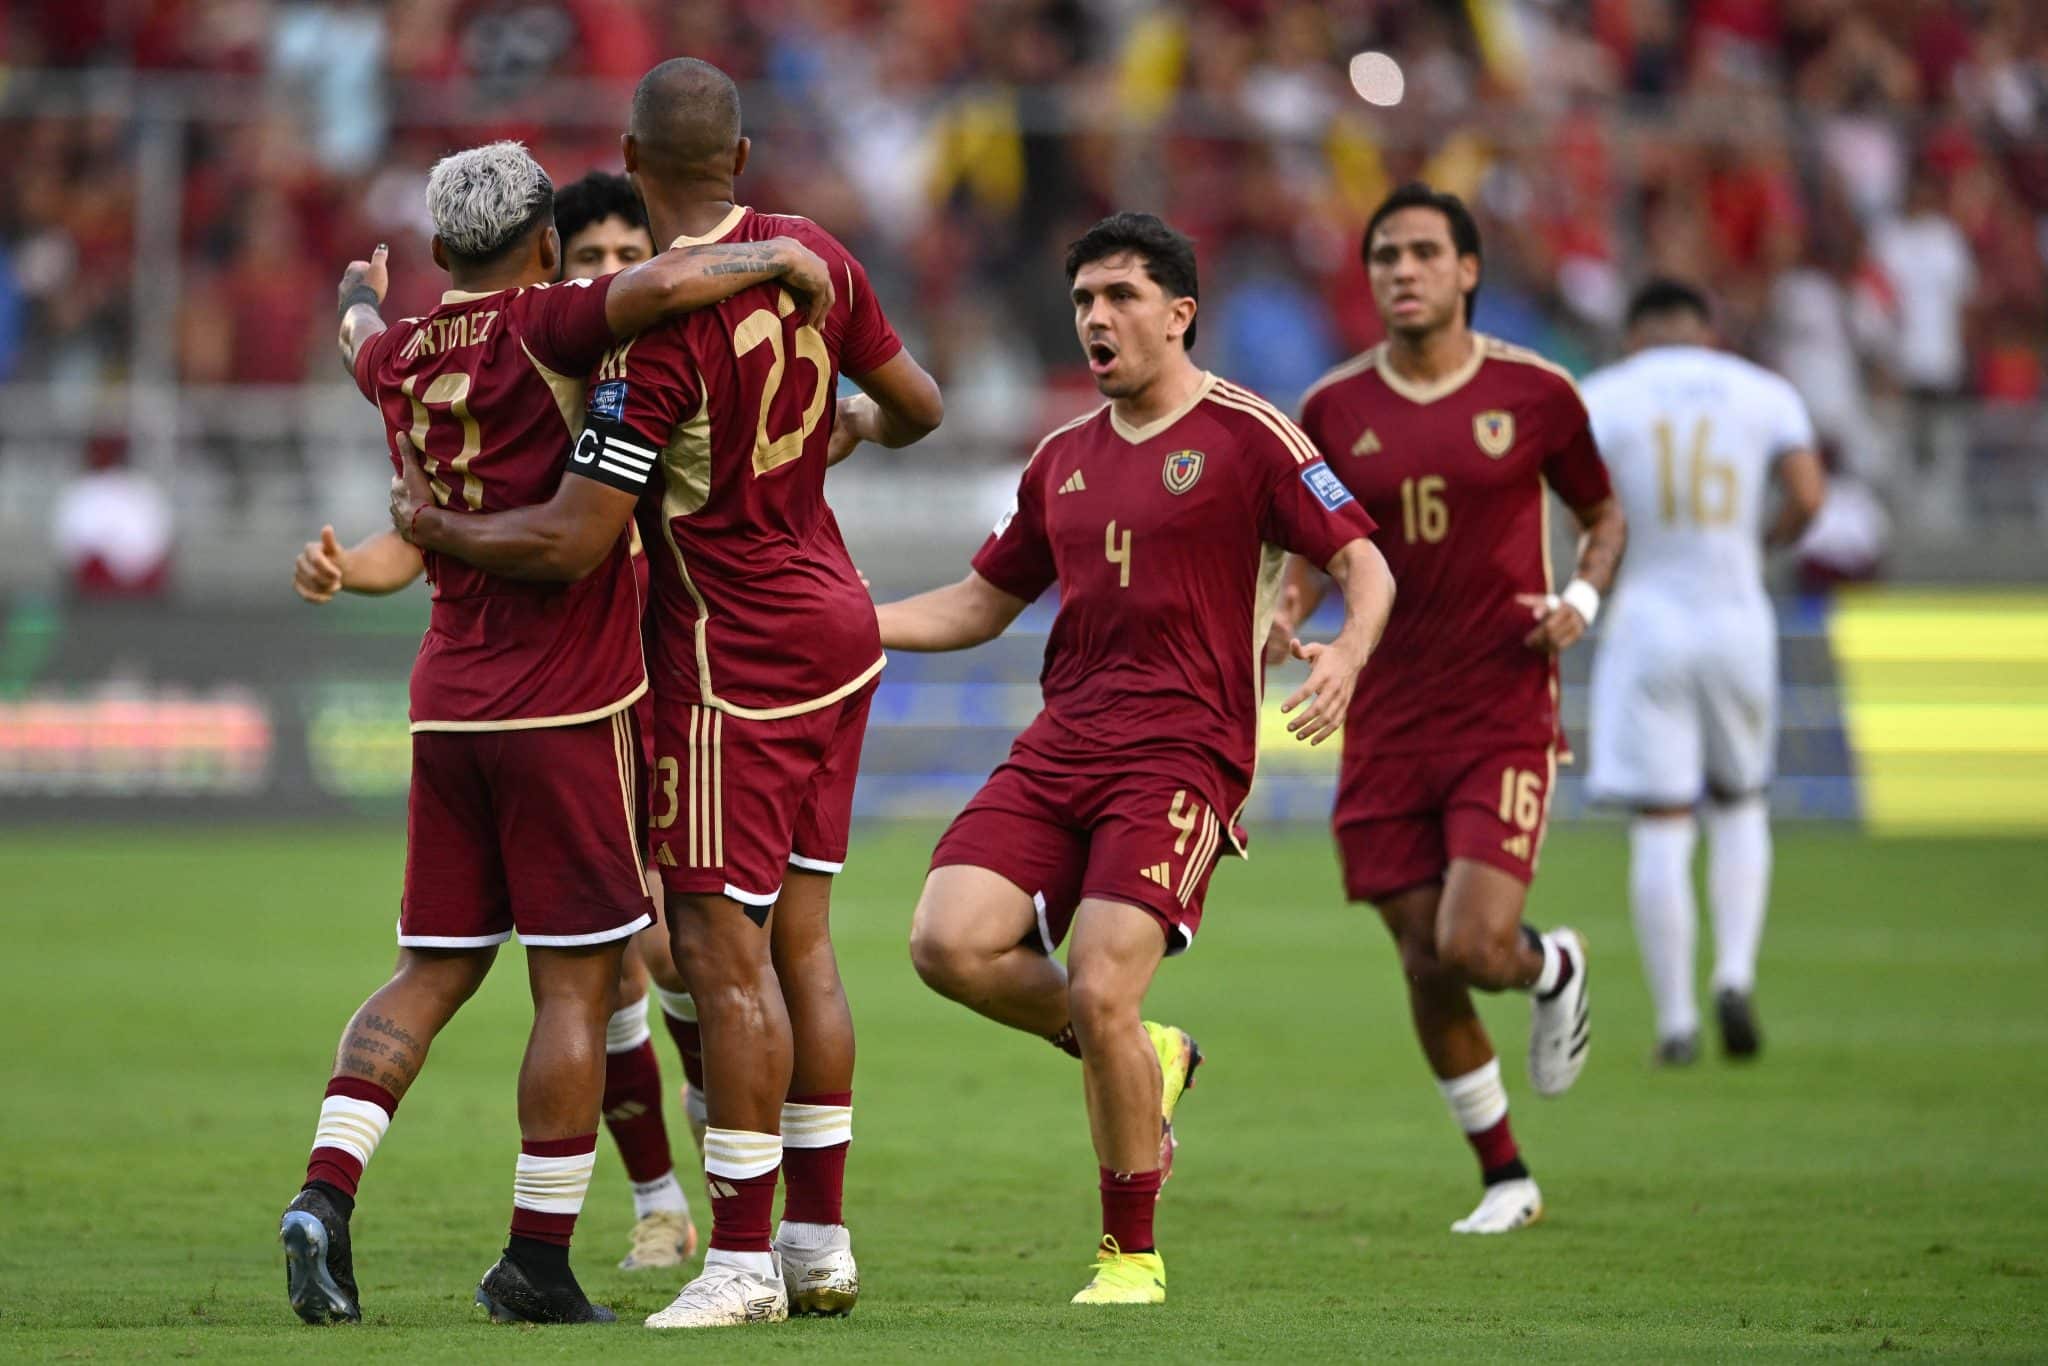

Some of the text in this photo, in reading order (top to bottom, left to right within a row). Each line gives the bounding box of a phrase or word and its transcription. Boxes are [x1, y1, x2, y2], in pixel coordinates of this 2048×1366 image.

[574, 428, 599, 464] C
[1650, 413, 1738, 528] 16
[1401, 475, 1448, 544] 16
[1105, 519, 1132, 588] 4
[648, 756, 679, 829] 3
[1168, 789, 1200, 856] 4
[1499, 767, 1542, 832] 16
